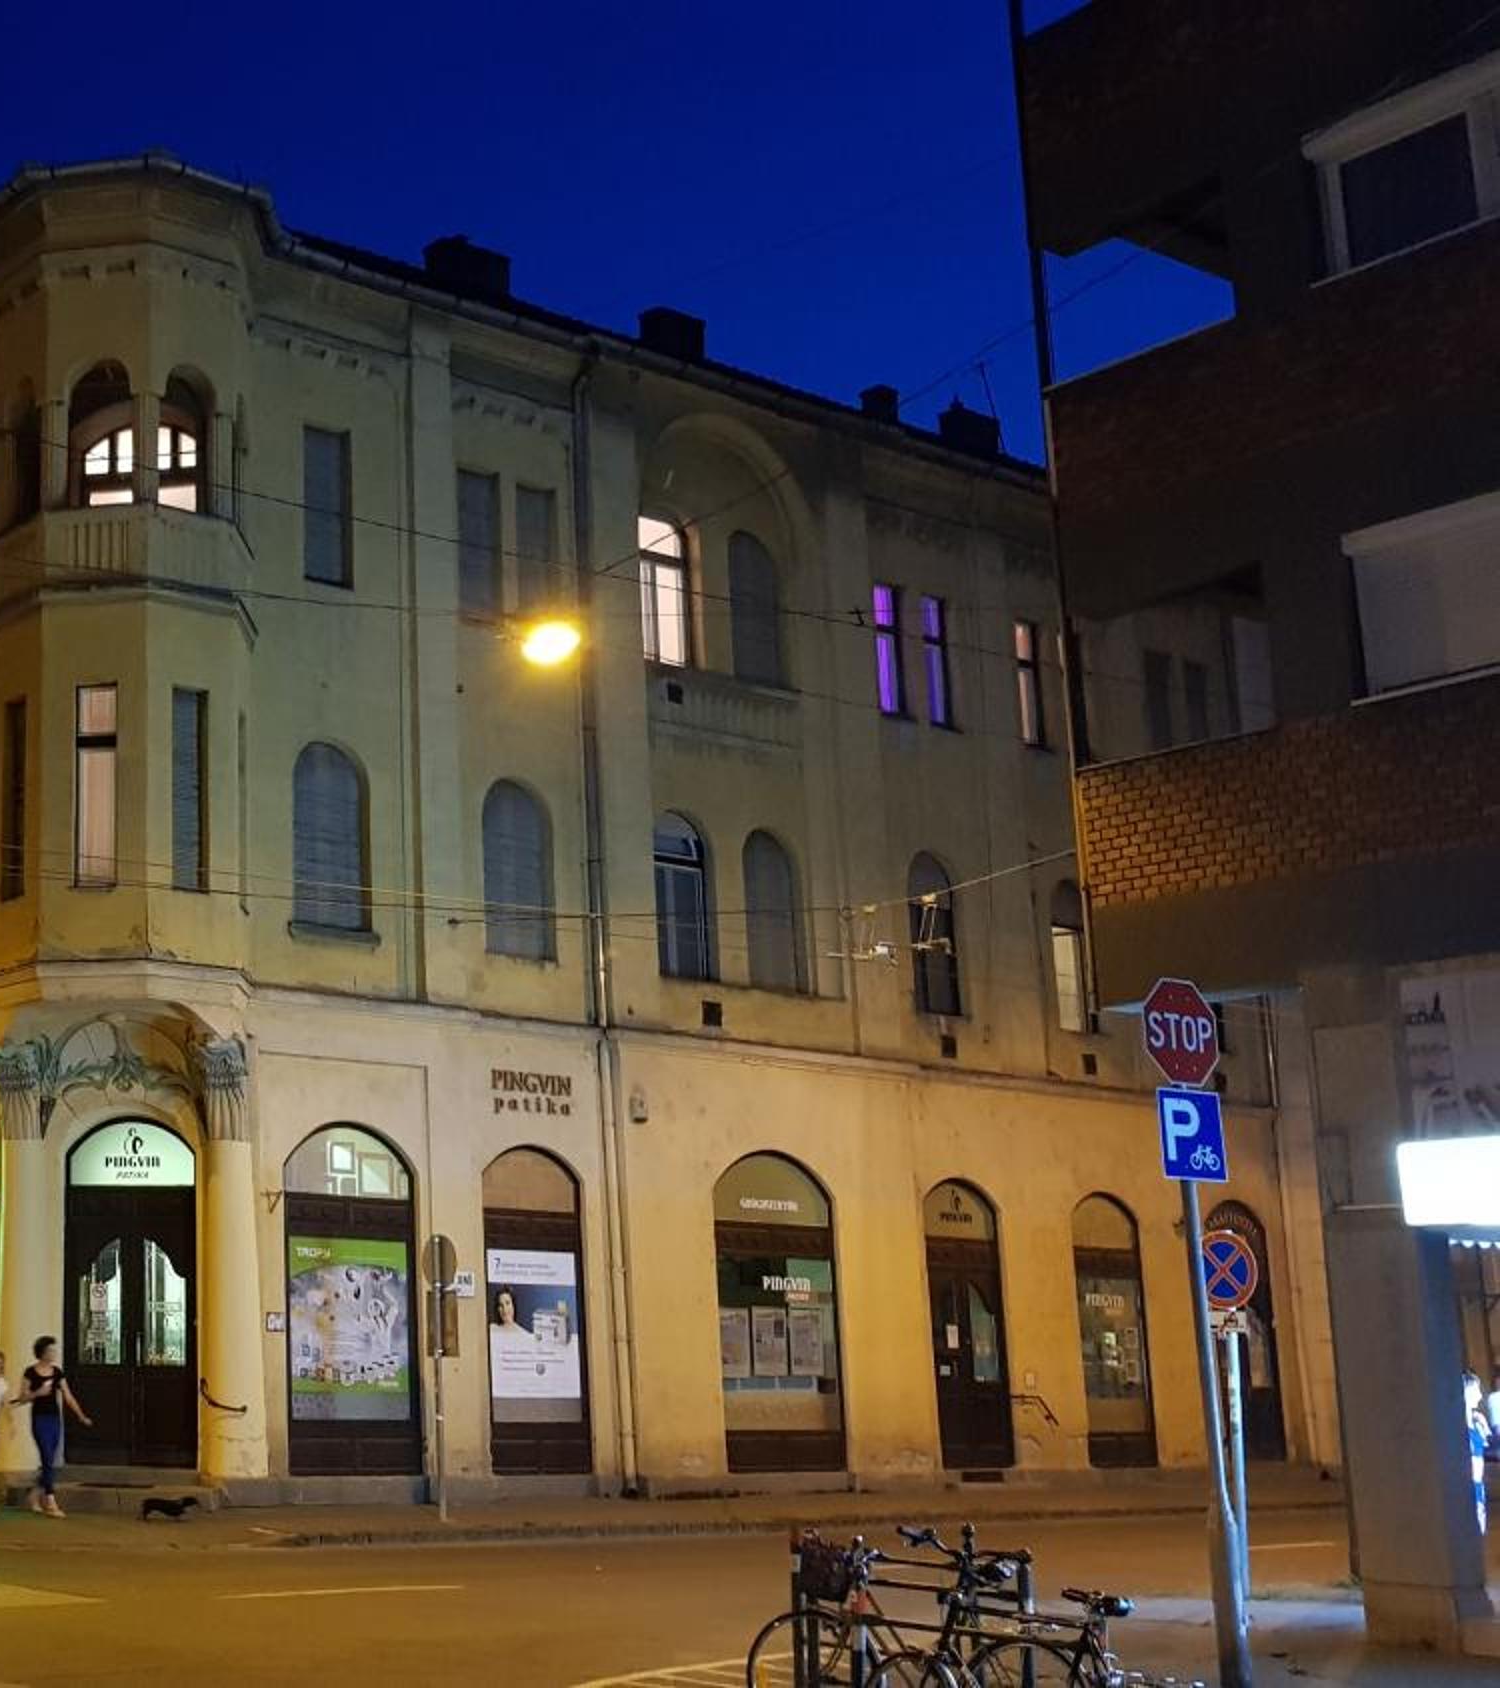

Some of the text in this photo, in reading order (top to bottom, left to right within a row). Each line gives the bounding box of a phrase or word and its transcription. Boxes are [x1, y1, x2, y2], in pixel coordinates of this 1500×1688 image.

[1149, 1010, 1213, 1054] STOP
[491, 1067, 572, 1097] PINGVIN
[493, 1096, 571, 1116] patika
[1163, 1096, 1200, 1161] P
[104, 1155, 161, 1168] PINGVIN
[762, 1275, 811, 1292] PINGVIN
